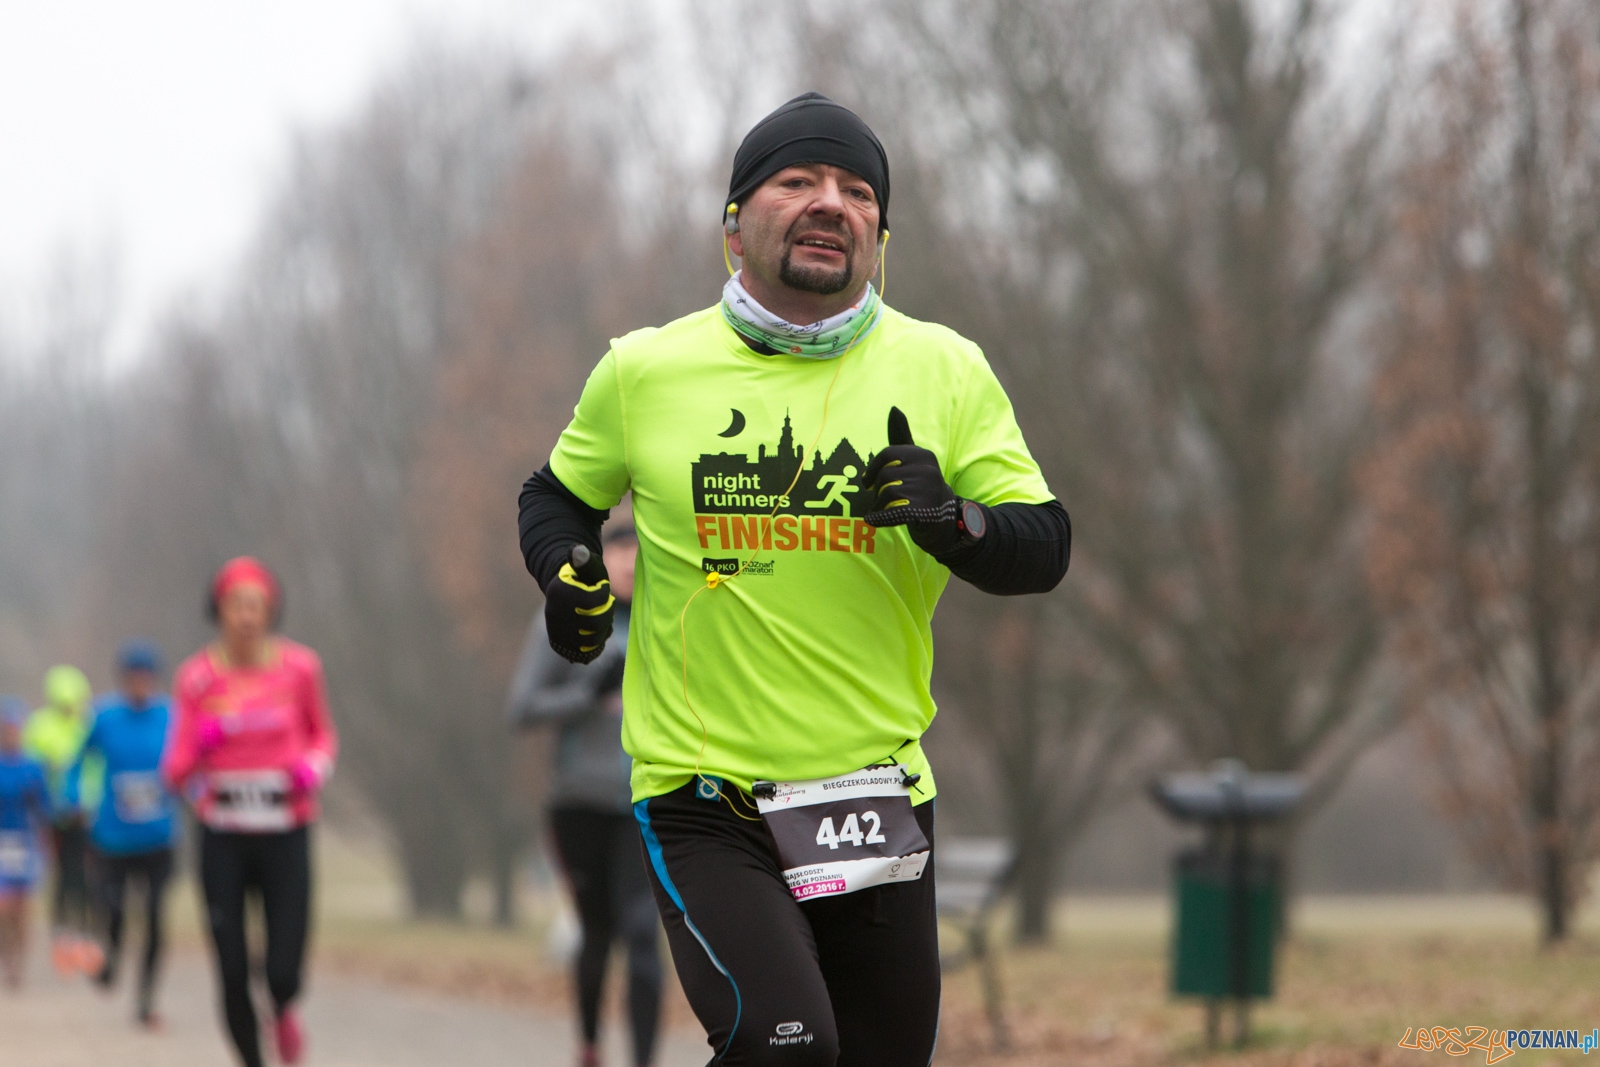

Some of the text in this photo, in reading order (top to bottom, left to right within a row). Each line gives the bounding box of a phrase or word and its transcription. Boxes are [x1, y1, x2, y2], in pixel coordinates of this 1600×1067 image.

[703, 472, 761, 493] night
[704, 493, 790, 508] runners
[695, 515, 877, 554] FINISHER
[705, 563, 736, 572] 16 PKO
[822, 777, 902, 791] BIEGCZEKOLADOWY.PL
[815, 810, 886, 850] 442
[785, 868, 824, 880] NAJSŁODSZY
[810, 873, 843, 882] POZNANIU
[769, 1033, 814, 1046] Kalenji
